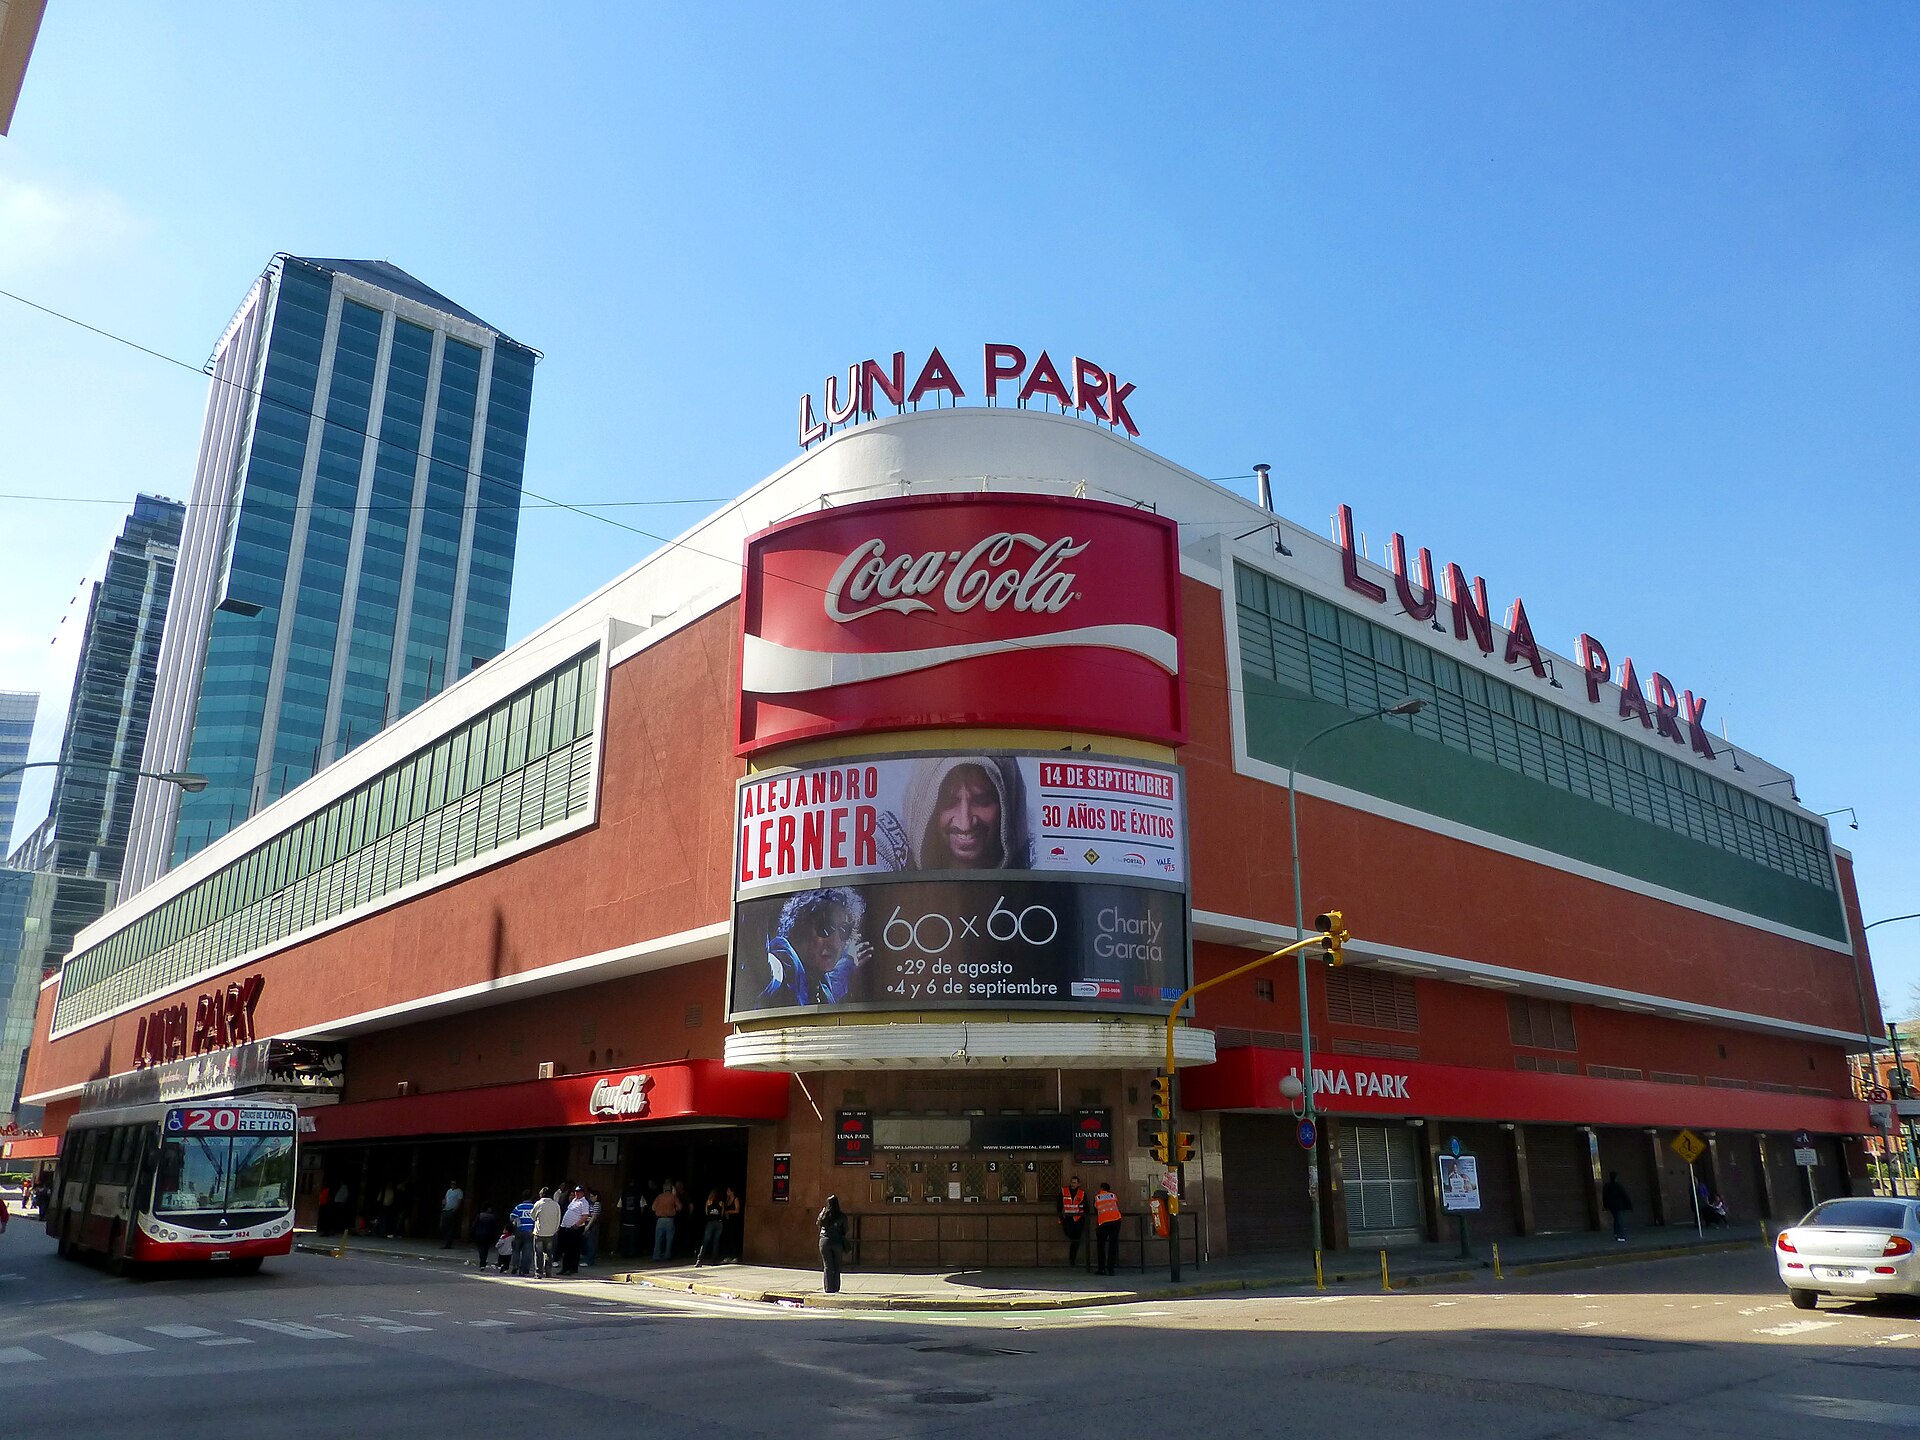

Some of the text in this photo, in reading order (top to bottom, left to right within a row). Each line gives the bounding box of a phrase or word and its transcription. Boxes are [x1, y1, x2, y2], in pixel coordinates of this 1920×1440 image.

[799, 343, 1141, 447] LUNA PARK
[824, 533, 1092, 622] Coca-Cola
[1338, 503, 1717, 760] LUNA PARK
[744, 766, 878, 819] ALEJANDRO
[1045, 766, 1169, 797] 14 DE SEPTIEMBRE
[1042, 803, 1174, 839] 30 AÑOS DE ÉXITOS
[742, 805, 877, 882] LERNER
[1156, 858, 1171, 866] VALE
[883, 905, 954, 954] 60
[987, 895, 1058, 946] 60
[1097, 906, 1163, 944] Charly
[1094, 933, 1162, 961] García
[931, 958, 952, 974] de
[958, 961, 1013, 978] agosto
[911, 984, 921, 999] y
[926, 979, 937, 994] 6
[943, 978, 963, 994] de
[969, 978, 1058, 999] septiembre
[191, 974, 265, 1053] PARK
[590, 1074, 650, 1116] Coca-Cola
[1355, 1072, 1410, 1099] PARK
[187, 1110, 236, 1131] 20
[263, 1110, 292, 1120] LOMAS
[239, 1120, 291, 1130] RETIRO
[601, 1144, 608, 1160] 1
[913, 1162, 1034, 1172] 1 2 3 4
